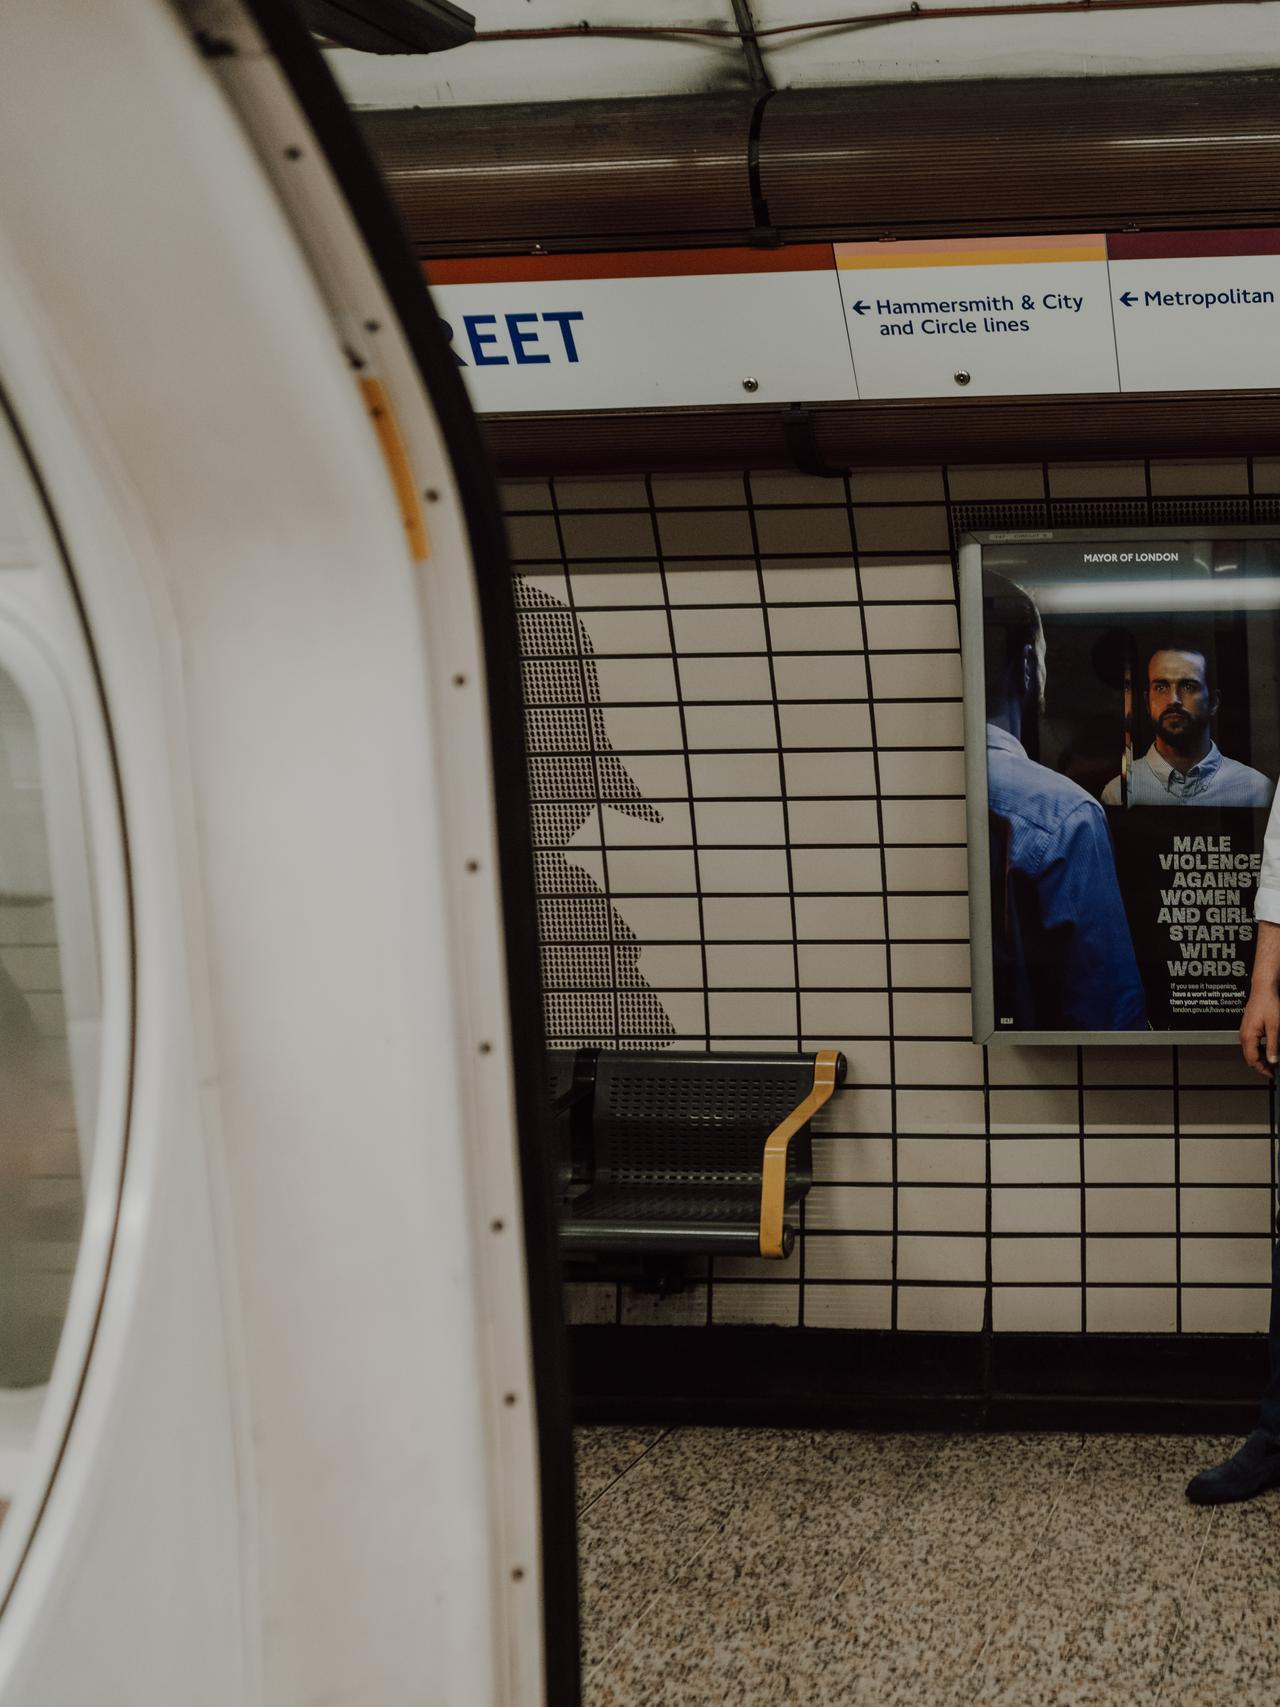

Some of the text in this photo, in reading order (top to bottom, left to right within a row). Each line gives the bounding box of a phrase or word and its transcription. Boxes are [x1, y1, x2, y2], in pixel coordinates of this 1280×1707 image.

[876, 293, 1083, 315] Hammersmith & City
[1144, 287, 1274, 310] Metropolitan
[880, 316, 1029, 336] and Circle lines
[1084, 552, 1178, 562] MAYOR OF LONDON
[1173, 836, 1230, 852] MALE
[1159, 854, 1261, 870] VIOLENCE
[1160, 890, 1240, 905] WOMEN
[1157, 908, 1200, 923] AND
[1170, 925, 1252, 941] STARTS
[1180, 943, 1236, 959] WITH
[1167, 960, 1248, 976] WORDS.
